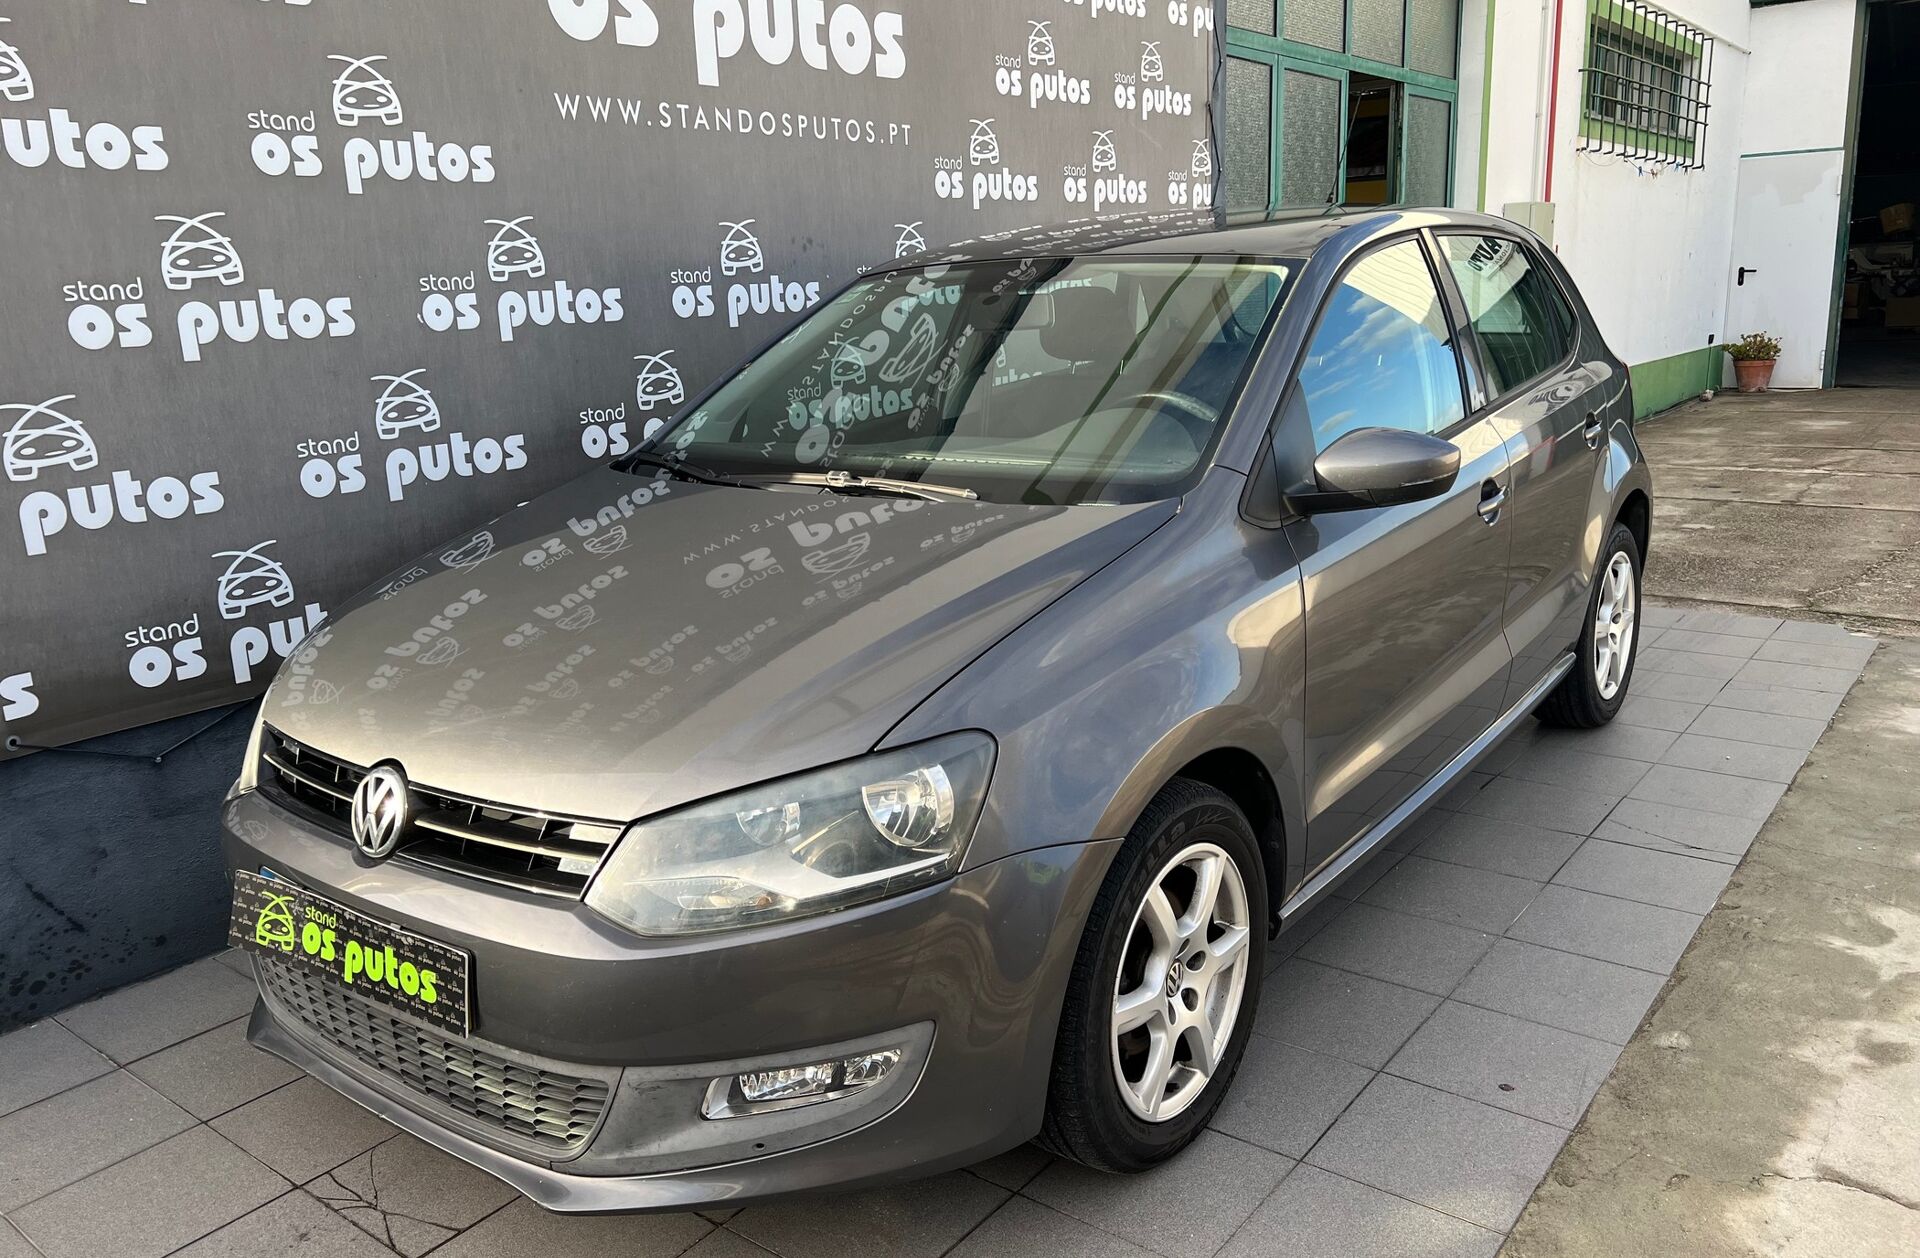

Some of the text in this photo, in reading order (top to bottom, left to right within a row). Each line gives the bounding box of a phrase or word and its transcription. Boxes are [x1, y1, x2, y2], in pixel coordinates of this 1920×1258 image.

[1168, 1, 1187, 25] os
[996, 54, 1020, 68] stand
[1115, 72, 1135, 84] stand
[996, 68, 1090, 108] os putos
[1115, 84, 1191, 120] os putos
[248, 110, 315, 132] stand
[554, 92, 911, 147] WWW.STANDOSPUTOS.PT
[251, 132, 495, 194] os putos
[935, 156, 962, 169] stand
[1064, 164, 1086, 176] stand
[1169, 170, 1187, 181] stand
[935, 168, 1037, 209] os putos
[1064, 174, 1147, 211] os putos
[1168, 182, 1187, 204] os
[63, 277, 142, 301] stand
[420, 271, 474, 291] stand
[671, 266, 711, 283] stand
[423, 281, 623, 341] os putos
[672, 275, 820, 327] os putos
[68, 289, 355, 361] os putos
[580, 403, 624, 423] stand
[297, 432, 359, 457] stand
[581, 421, 630, 460] os
[300, 432, 527, 501] os putos
[20, 470, 224, 555] putos
[125, 614, 202, 652] stand
[128, 636, 208, 689] os
[304, 905, 338, 929] stand
[301, 922, 336, 962] os
[344, 940, 437, 1004] putos
